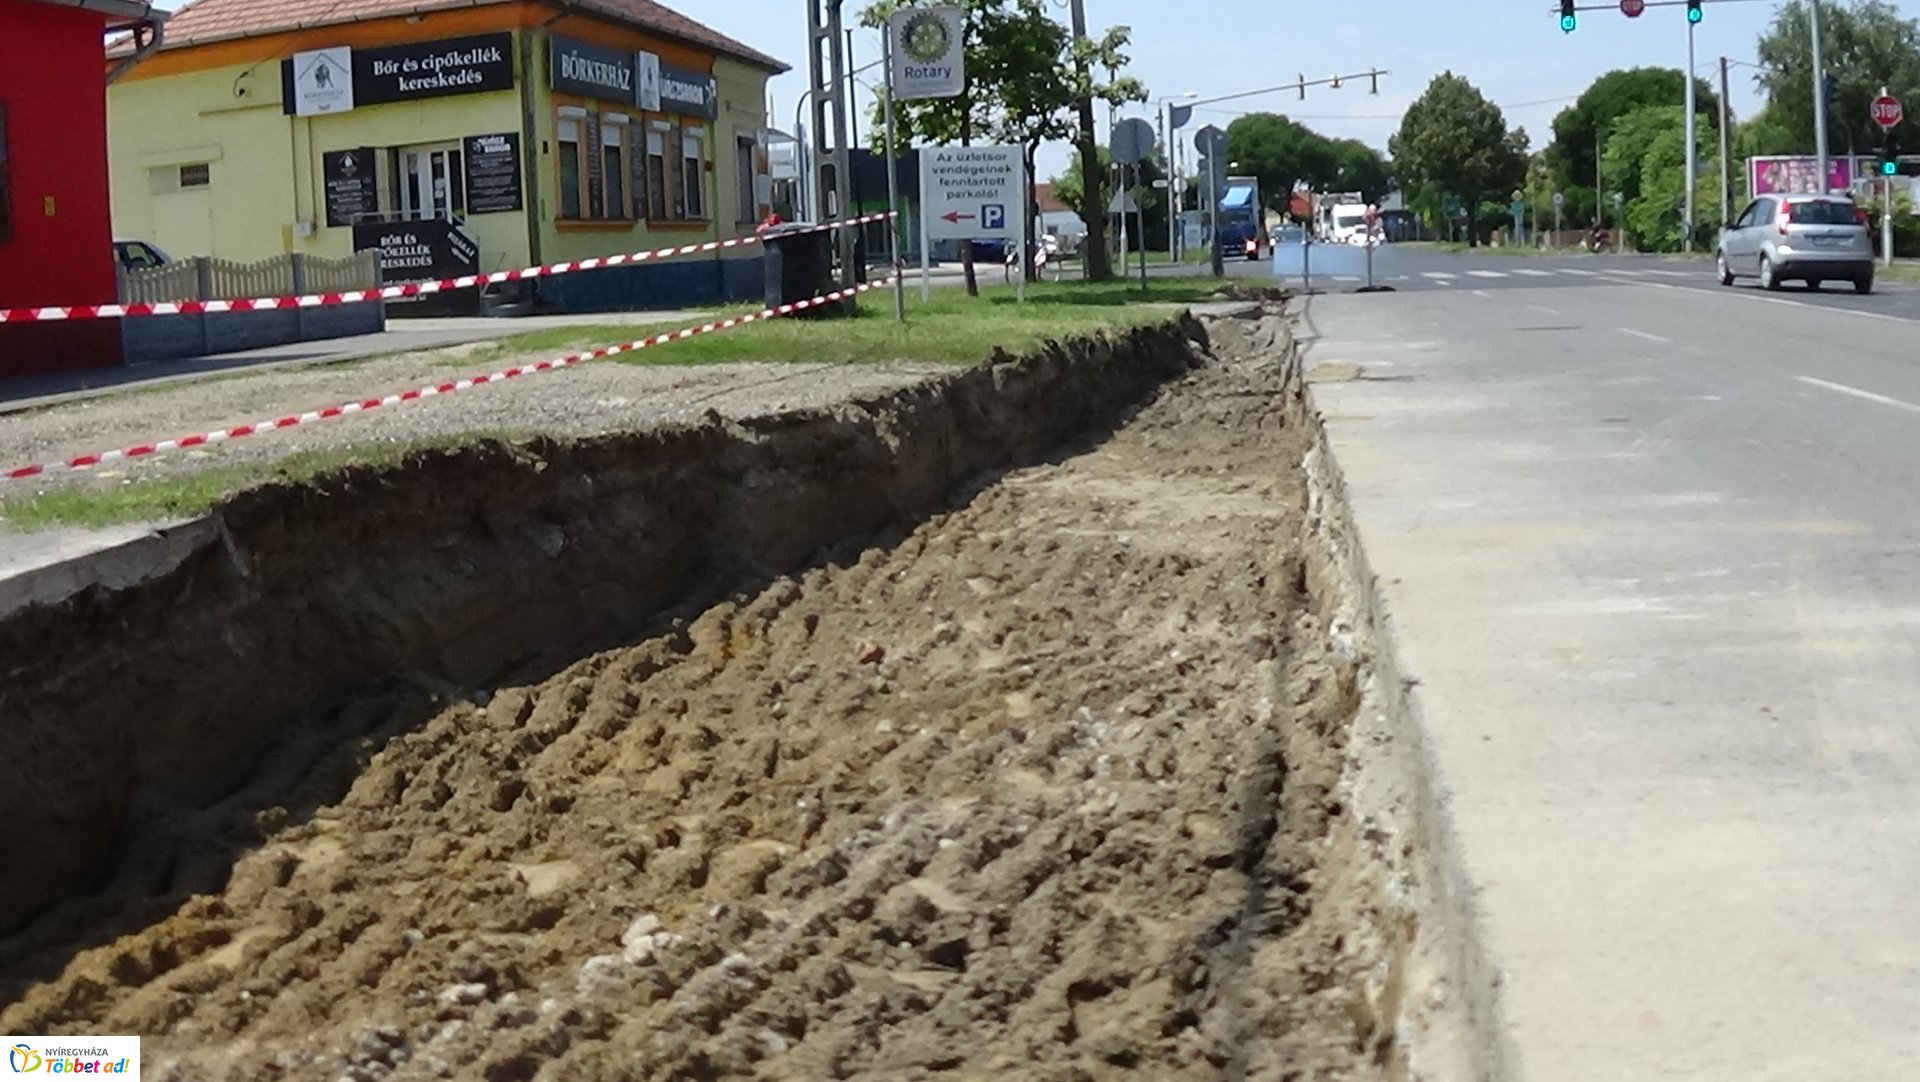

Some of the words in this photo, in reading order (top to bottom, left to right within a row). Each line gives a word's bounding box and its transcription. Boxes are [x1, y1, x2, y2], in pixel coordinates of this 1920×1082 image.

[374, 60, 399, 76] Bőr
[402, 58, 418, 72] és
[421, 46, 502, 73] cipőkellék
[562, 50, 630, 91] BŐRKERHÁZ
[904, 66, 951, 79] Rotary
[399, 69, 482, 91] kereskedés
[1873, 104, 1899, 118] STOP
[937, 153, 952, 162] Az
[957, 152, 1007, 162] üzletsor
[932, 165, 1012, 175] vendégeinek
[939, 177, 1006, 187] fenntartott
[946, 189, 998, 200] parkoló!
[985, 206, 1002, 228] P
[381, 234, 402, 247] BŐR
[404, 233, 417, 245] ÉS
[380, 255, 433, 269] RESKEDÉS
